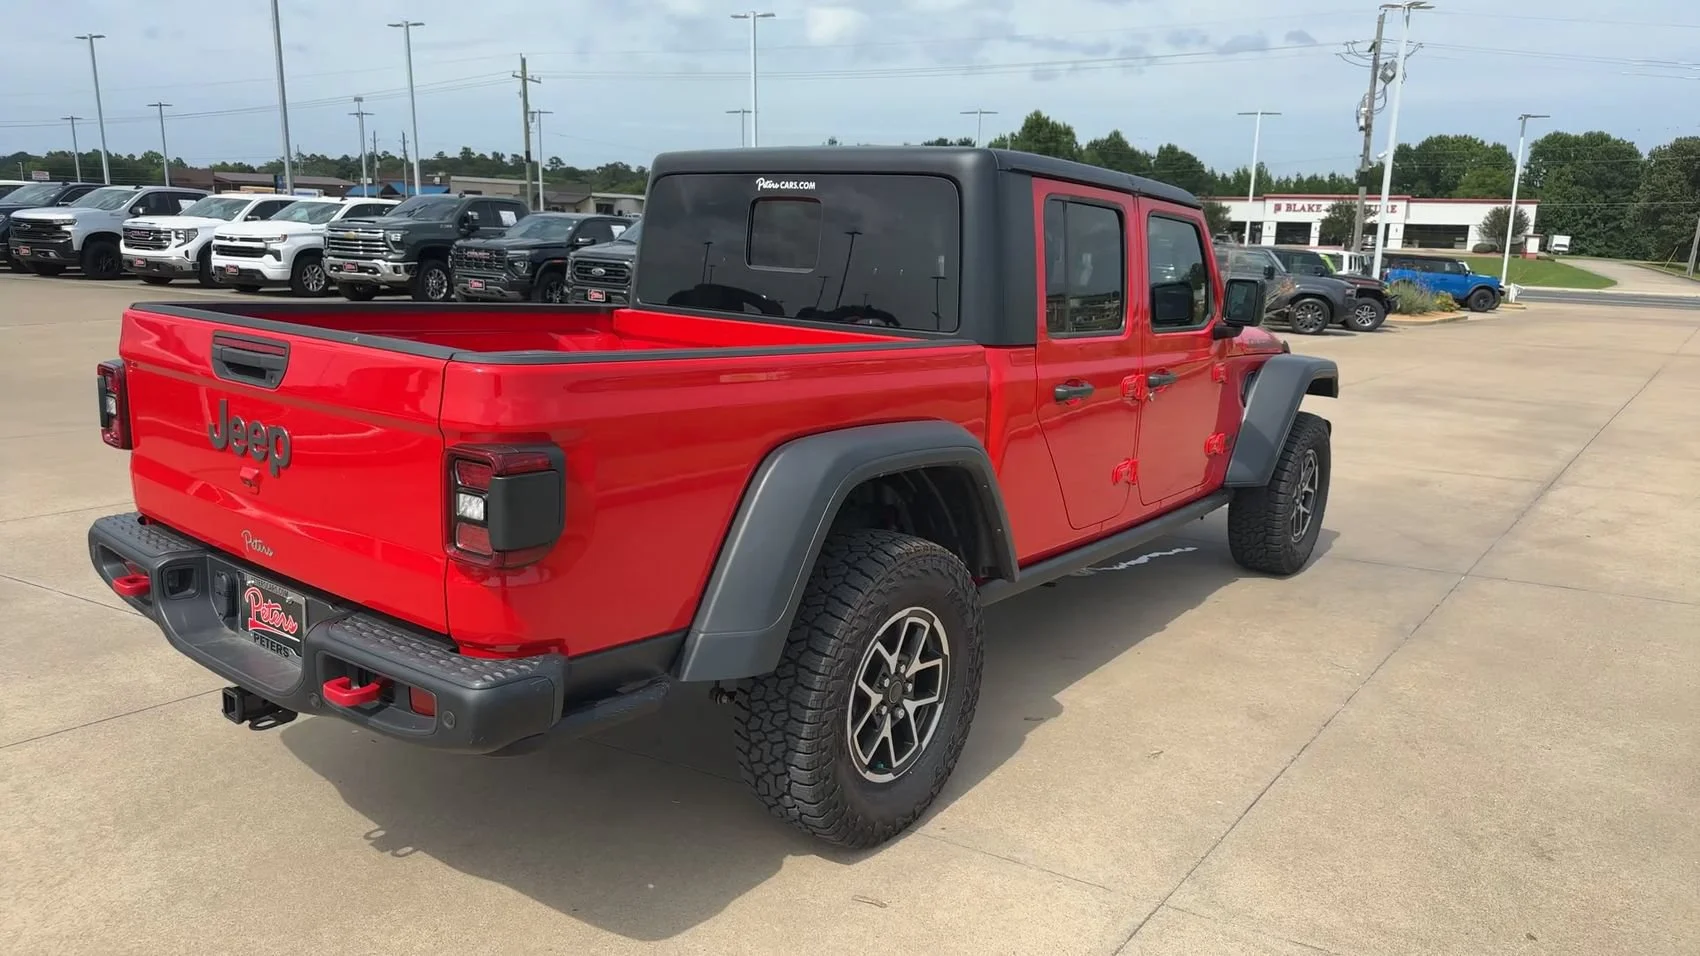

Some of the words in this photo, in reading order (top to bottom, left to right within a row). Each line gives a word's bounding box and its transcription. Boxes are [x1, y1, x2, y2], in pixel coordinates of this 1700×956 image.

[1285, 203, 1322, 213] BLAKE
[208, 399, 291, 478] Jeep
[241, 529, 274, 557] Peters
[244, 586, 298, 637] Peters
[253, 632, 290, 658] PETERS
